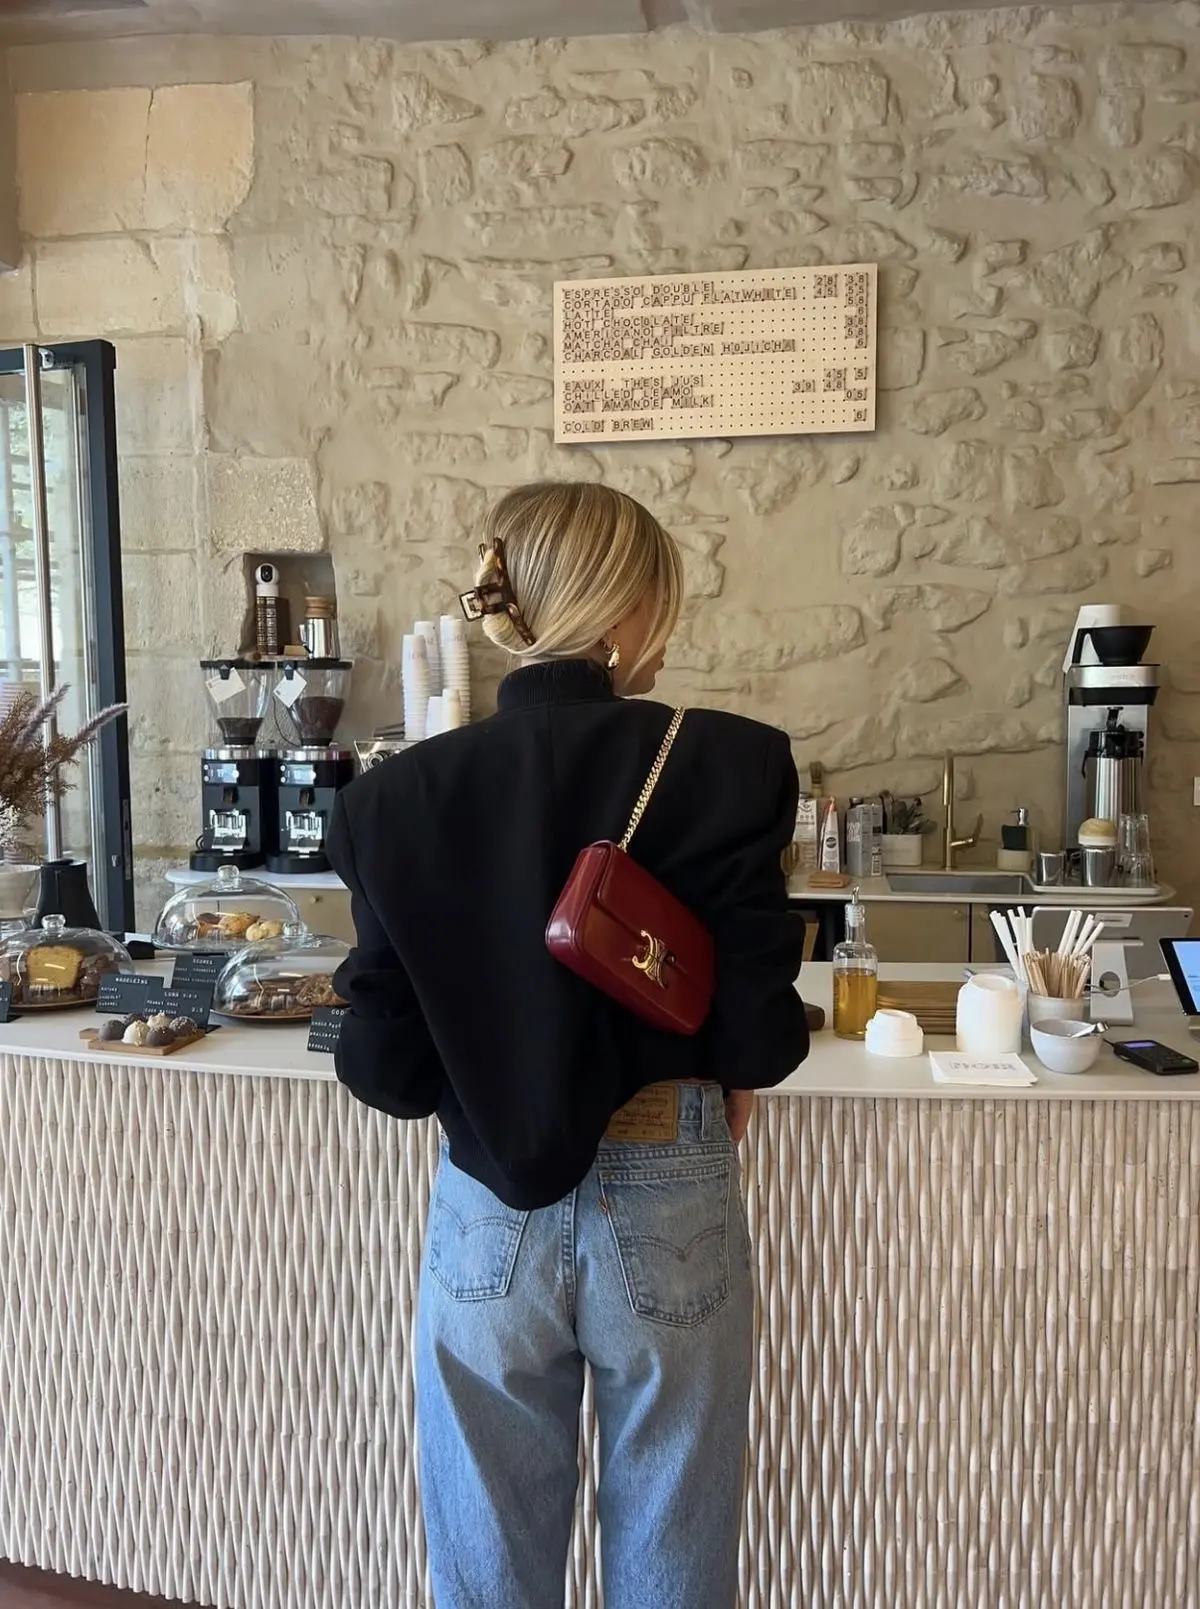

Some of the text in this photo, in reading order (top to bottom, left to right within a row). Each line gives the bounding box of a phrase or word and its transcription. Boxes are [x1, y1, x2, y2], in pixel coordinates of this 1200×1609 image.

[564, 287, 641, 299] ESPRESSO
[652, 282, 710, 294] DOUBLE
[564, 296, 632, 309] CORTADO
[643, 293, 692, 306] CAPPU
[703, 288, 792, 302] FLATWHITE
[564, 308, 610, 320] LATTE
[564, 320, 591, 330] HOT
[564, 326, 651, 340] AMERICANO
[663, 323, 720, 335] FILTRE
[564, 338, 622, 351] MATCHA
[633, 338, 670, 347] CHAI
[564, 348, 641, 361] CHARCOAL
[652, 344, 711, 356] GOLDEN
[564, 381, 602, 391] EAUX
[673, 376, 701, 386] JUS
[564, 388, 632, 401] CHILLED
[564, 401, 591, 412] OAT
[672, 396, 710, 407] MILK
[564, 421, 602, 432] COLD
[613, 418, 651, 430] BREW
